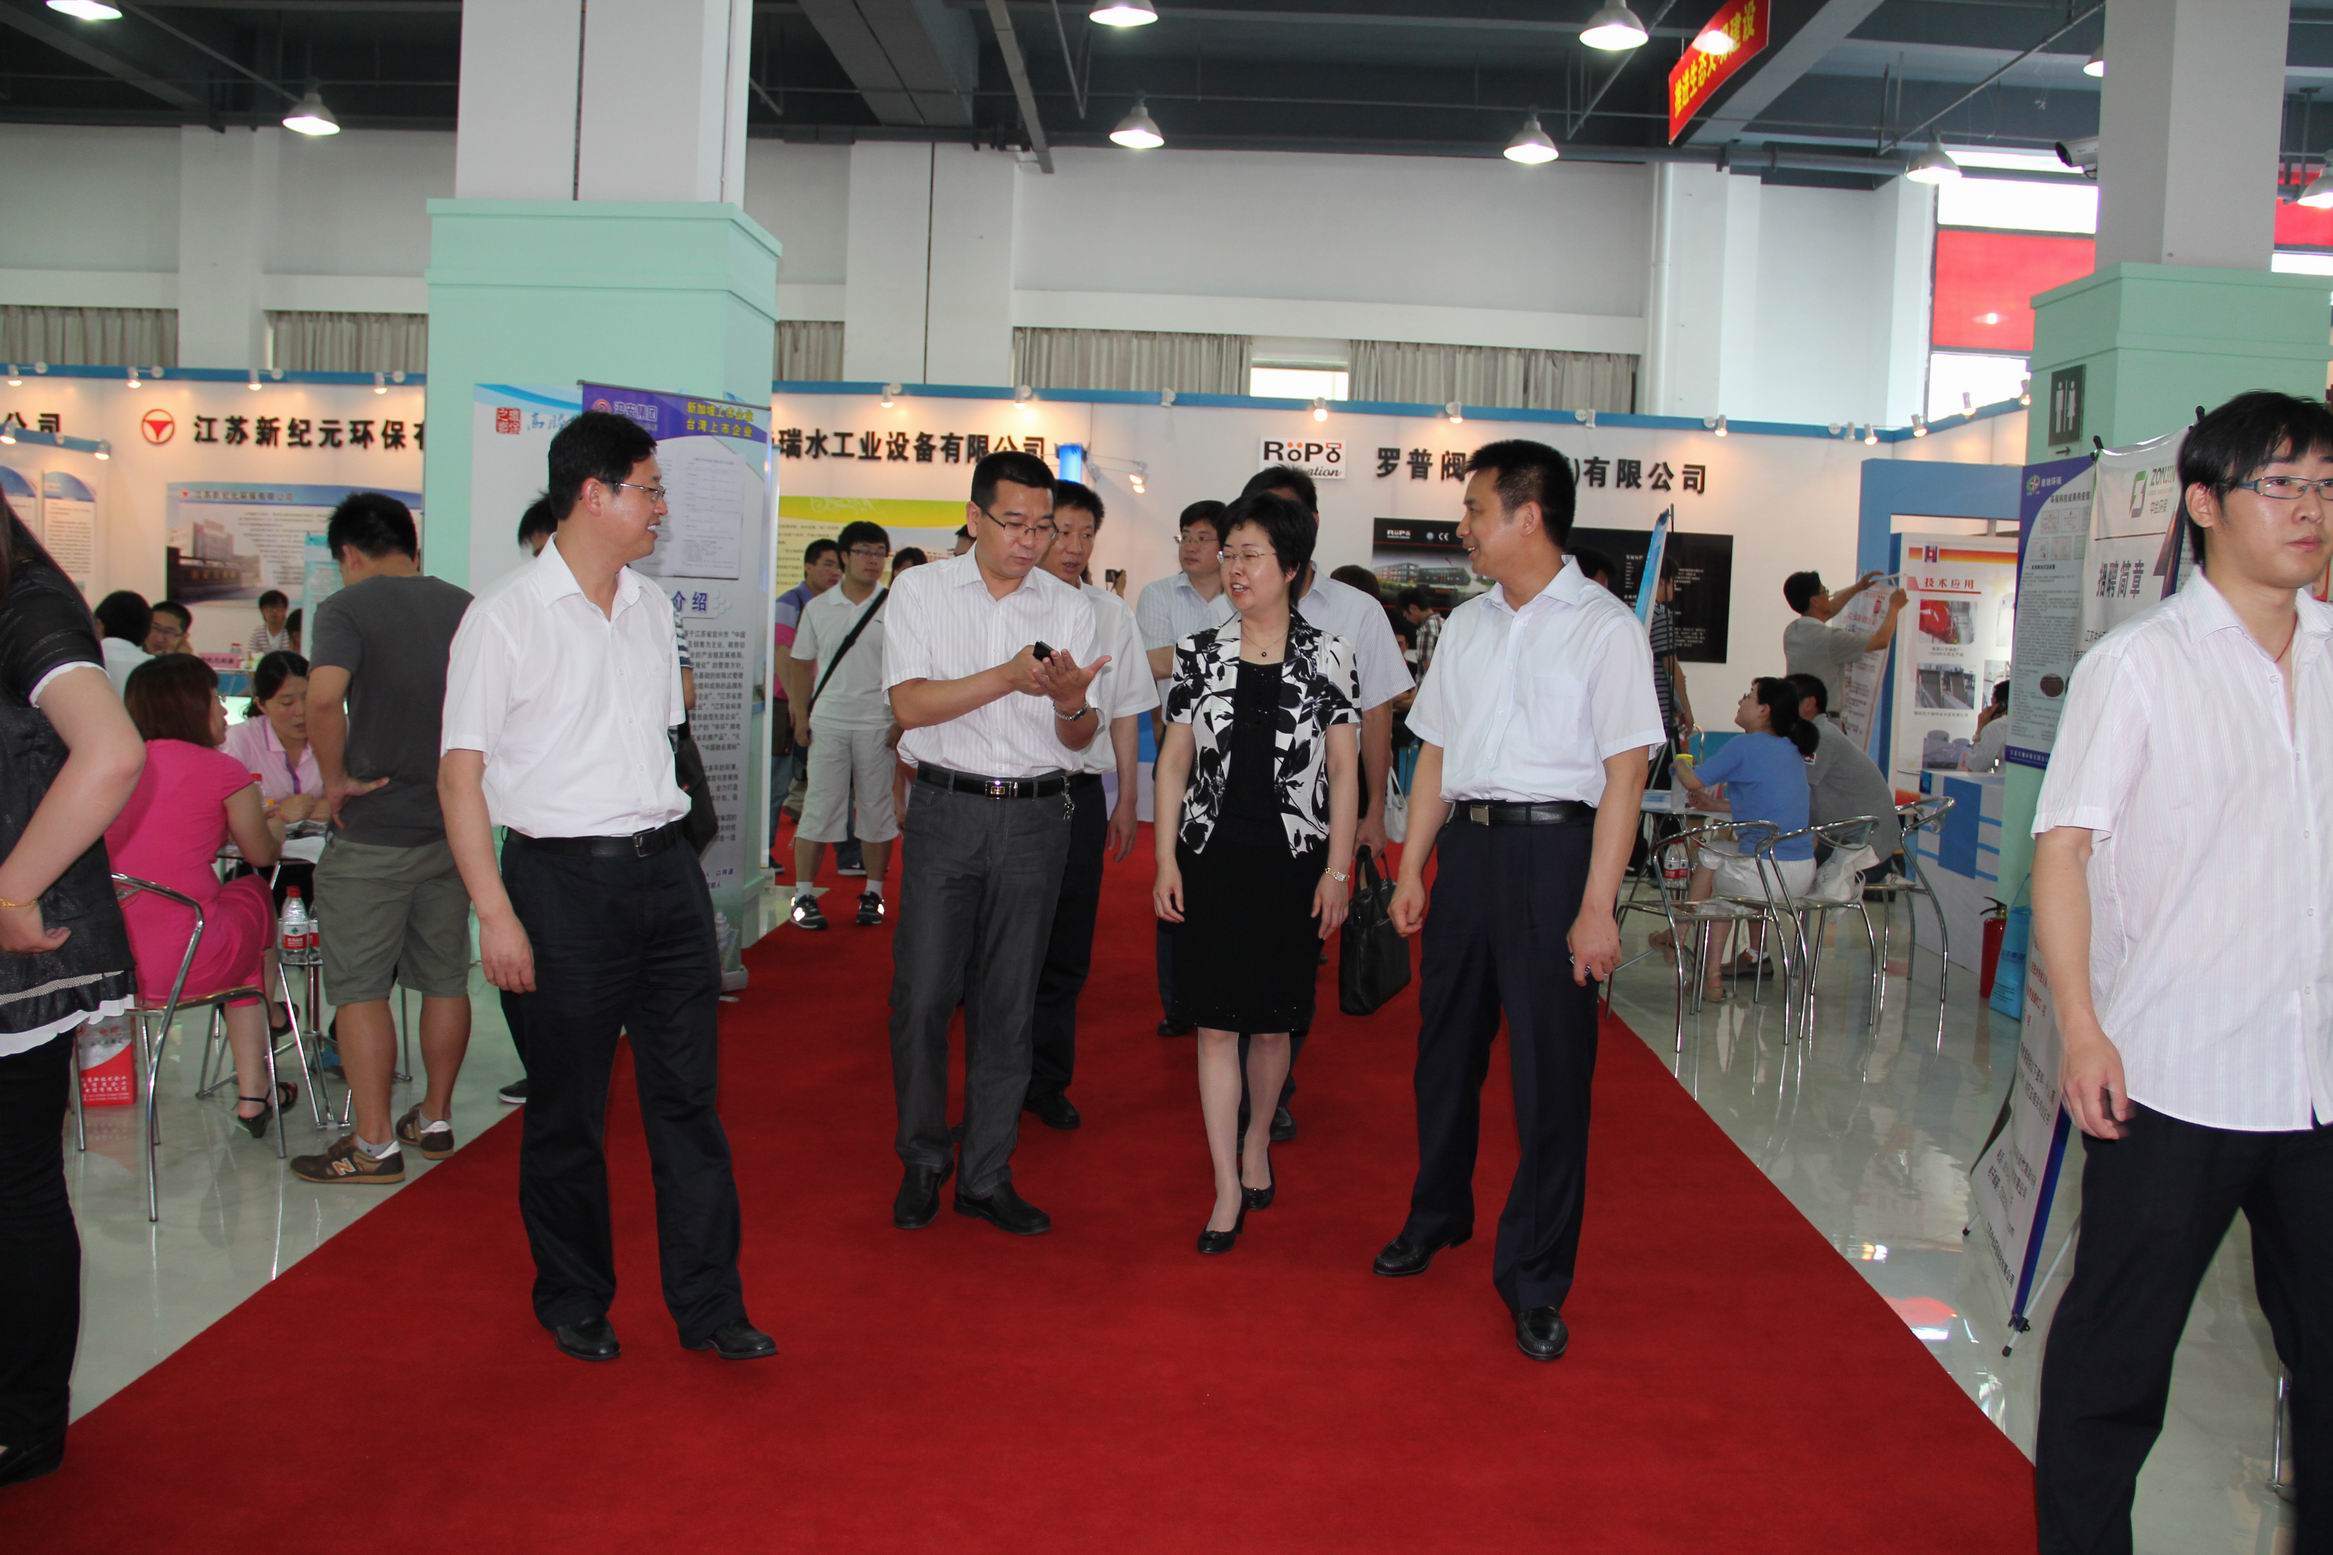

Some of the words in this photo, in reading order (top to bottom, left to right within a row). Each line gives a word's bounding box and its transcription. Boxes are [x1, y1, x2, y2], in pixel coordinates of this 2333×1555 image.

[772, 428, 1044, 463] 瑞水工业设备有限公司
[1924, 577, 1974, 590] 技术应用
[2096, 559, 2144, 599] 招聘简章
